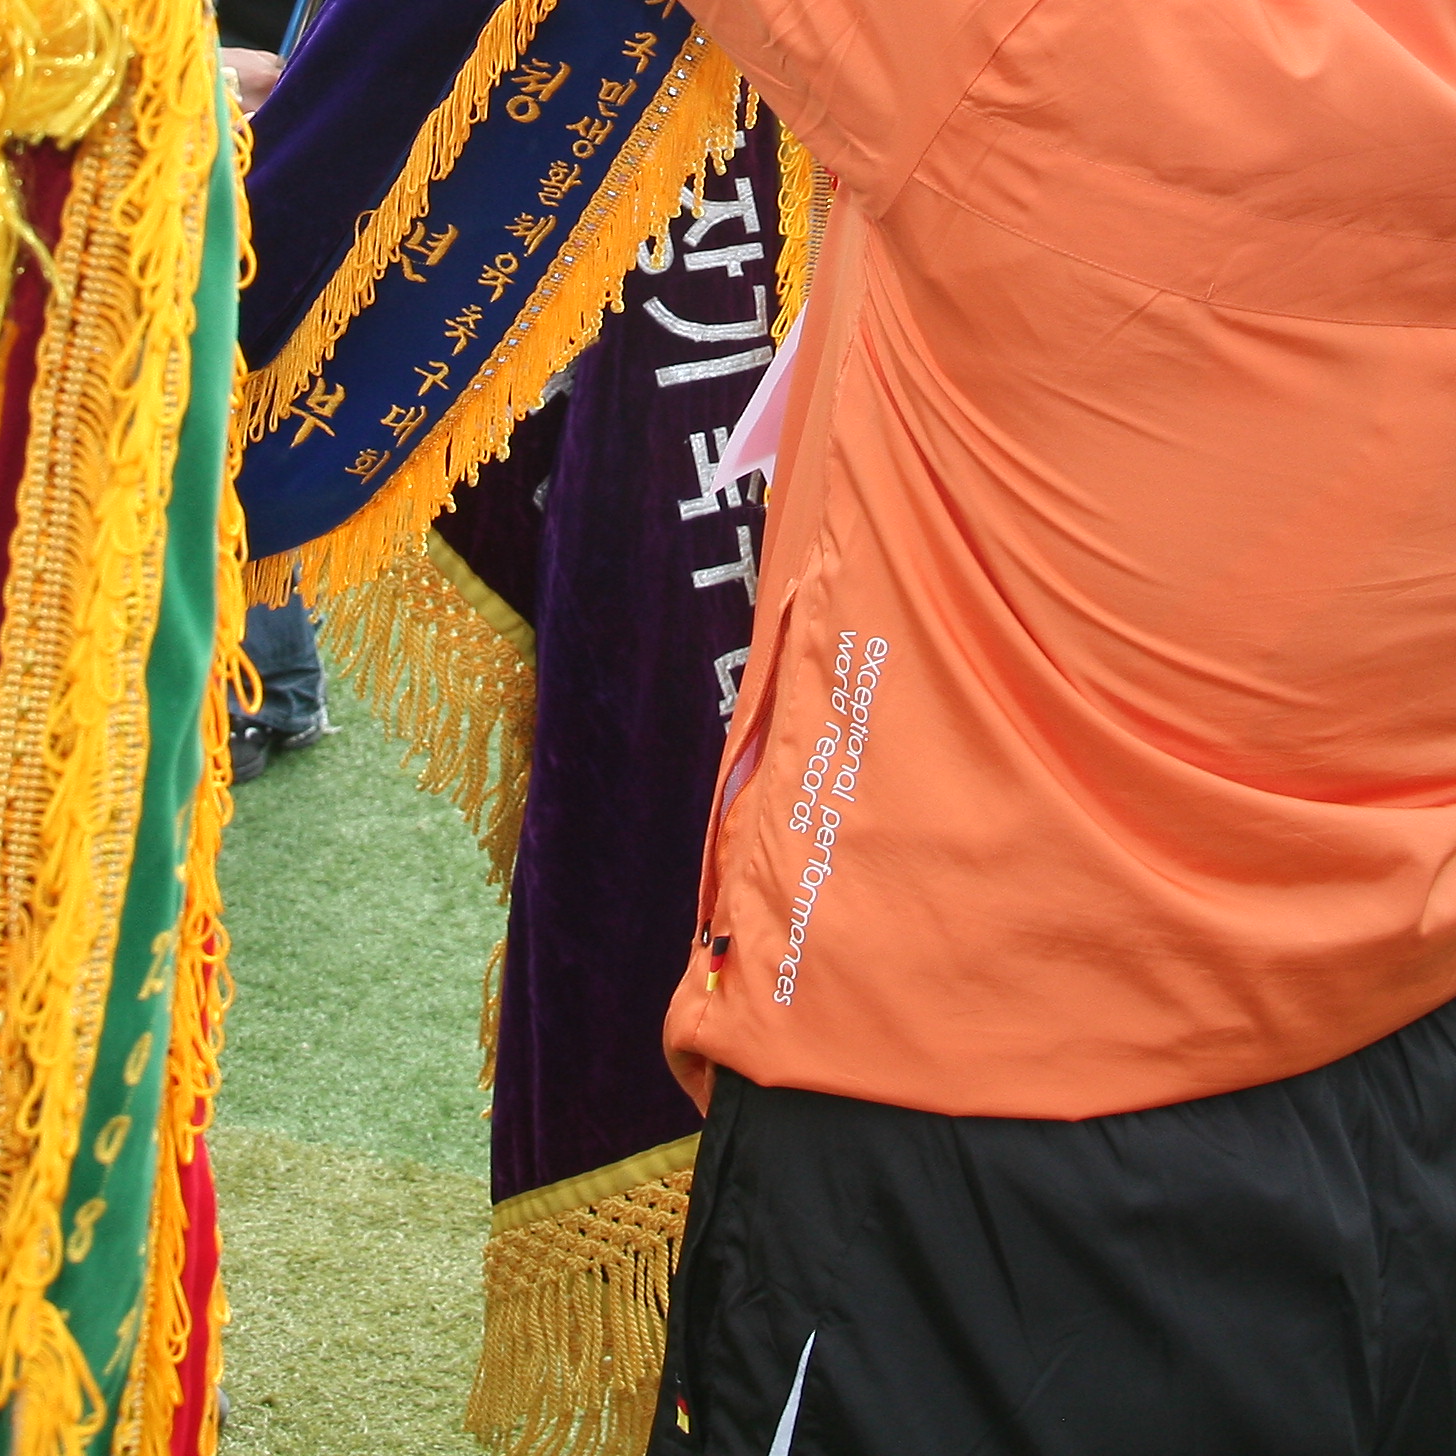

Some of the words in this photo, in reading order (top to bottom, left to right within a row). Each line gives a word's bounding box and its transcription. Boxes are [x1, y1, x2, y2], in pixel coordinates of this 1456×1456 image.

[830, 628, 858, 716] world
[830, 635, 890, 803] exceptional
[788, 720, 843, 834] records
[772, 802, 842, 1007] performances
